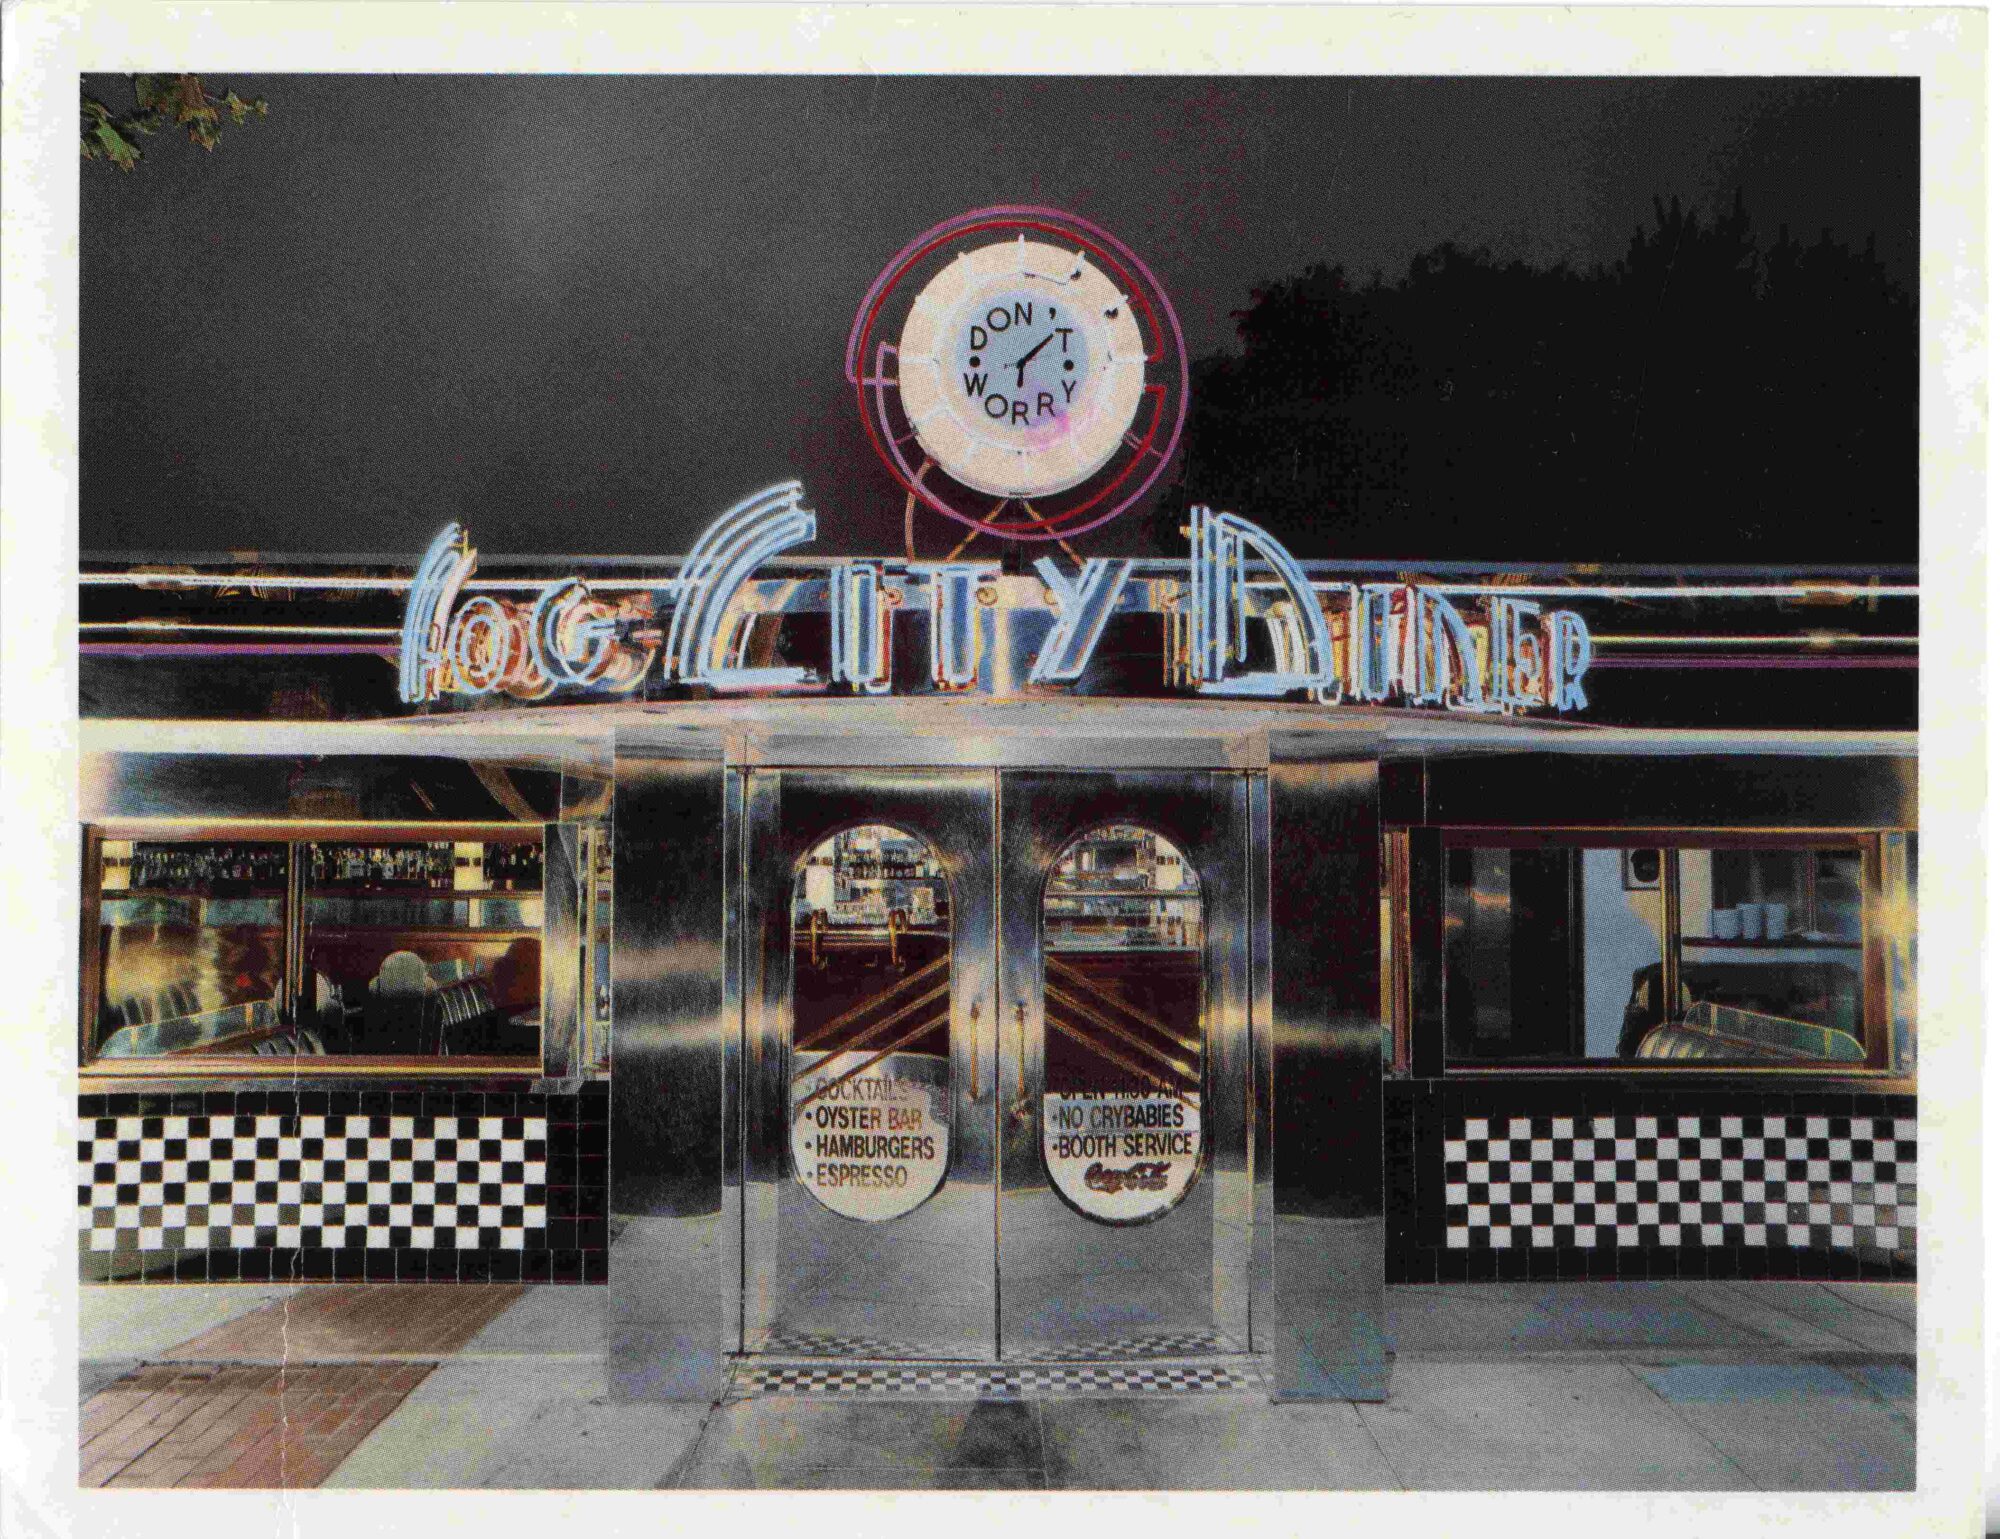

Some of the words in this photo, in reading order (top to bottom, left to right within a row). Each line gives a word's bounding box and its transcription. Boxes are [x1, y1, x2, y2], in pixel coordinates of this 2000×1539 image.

[970, 301, 1074, 353] DON'T
[963, 372, 1077, 426] WORRY
[815, 1104, 881, 1130] OYSTER
[887, 1106, 923, 1131] BAR
[1059, 1104, 1084, 1130] NO
[1090, 1102, 1184, 1128] CRYBABIES
[816, 1134, 935, 1161] HAMBURGERS
[1059, 1134, 1117, 1160] BOOTH
[1122, 1131, 1193, 1158] SERVICE
[816, 1162, 909, 1189] ESPRESSO
